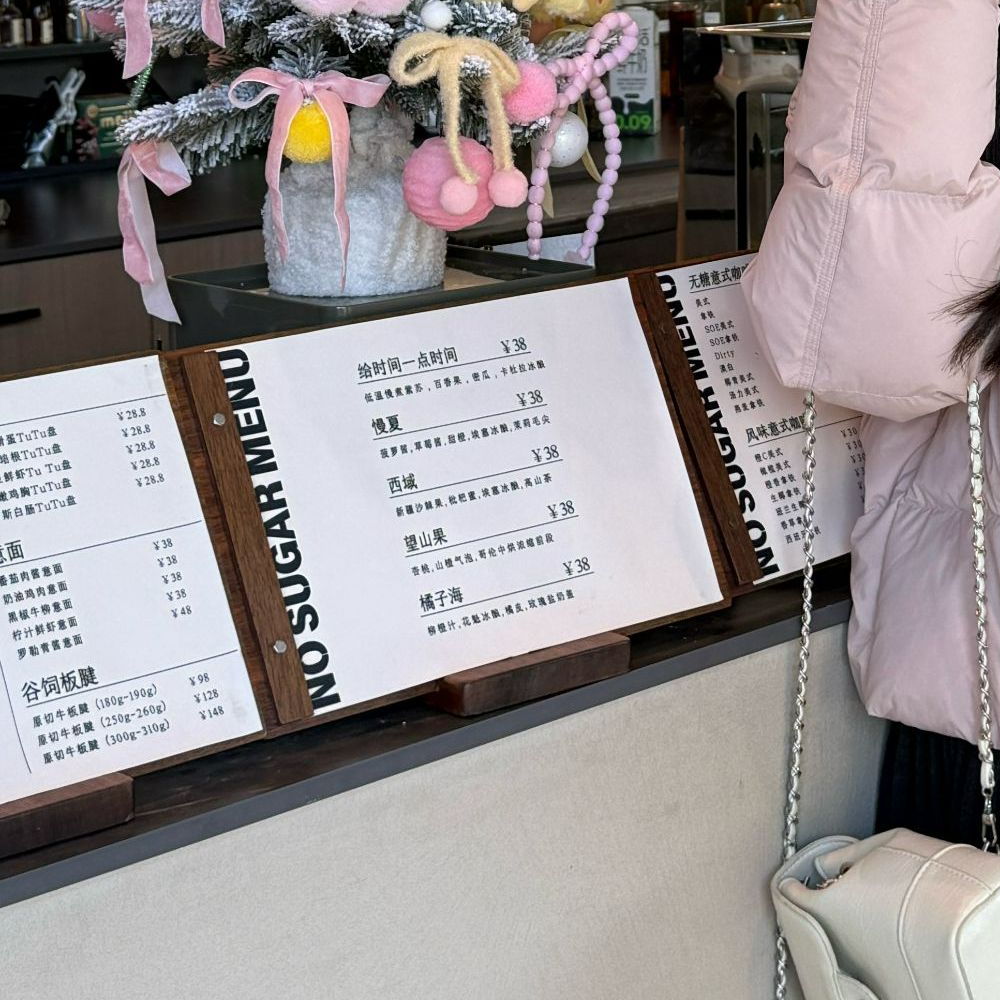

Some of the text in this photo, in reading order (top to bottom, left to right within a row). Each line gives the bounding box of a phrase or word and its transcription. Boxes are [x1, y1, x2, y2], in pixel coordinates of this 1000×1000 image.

[358, 347, 458, 379] 给时间一点时间
[714, 350, 734, 360] Dirty
[372, 414, 403, 436] 慢夏
[387, 473, 418, 494] 西域
[216, 348, 342, 709] NO SUGAR MENU
[403, 527, 448, 553] 望山果
[419, 587, 464, 612] 橘子海
